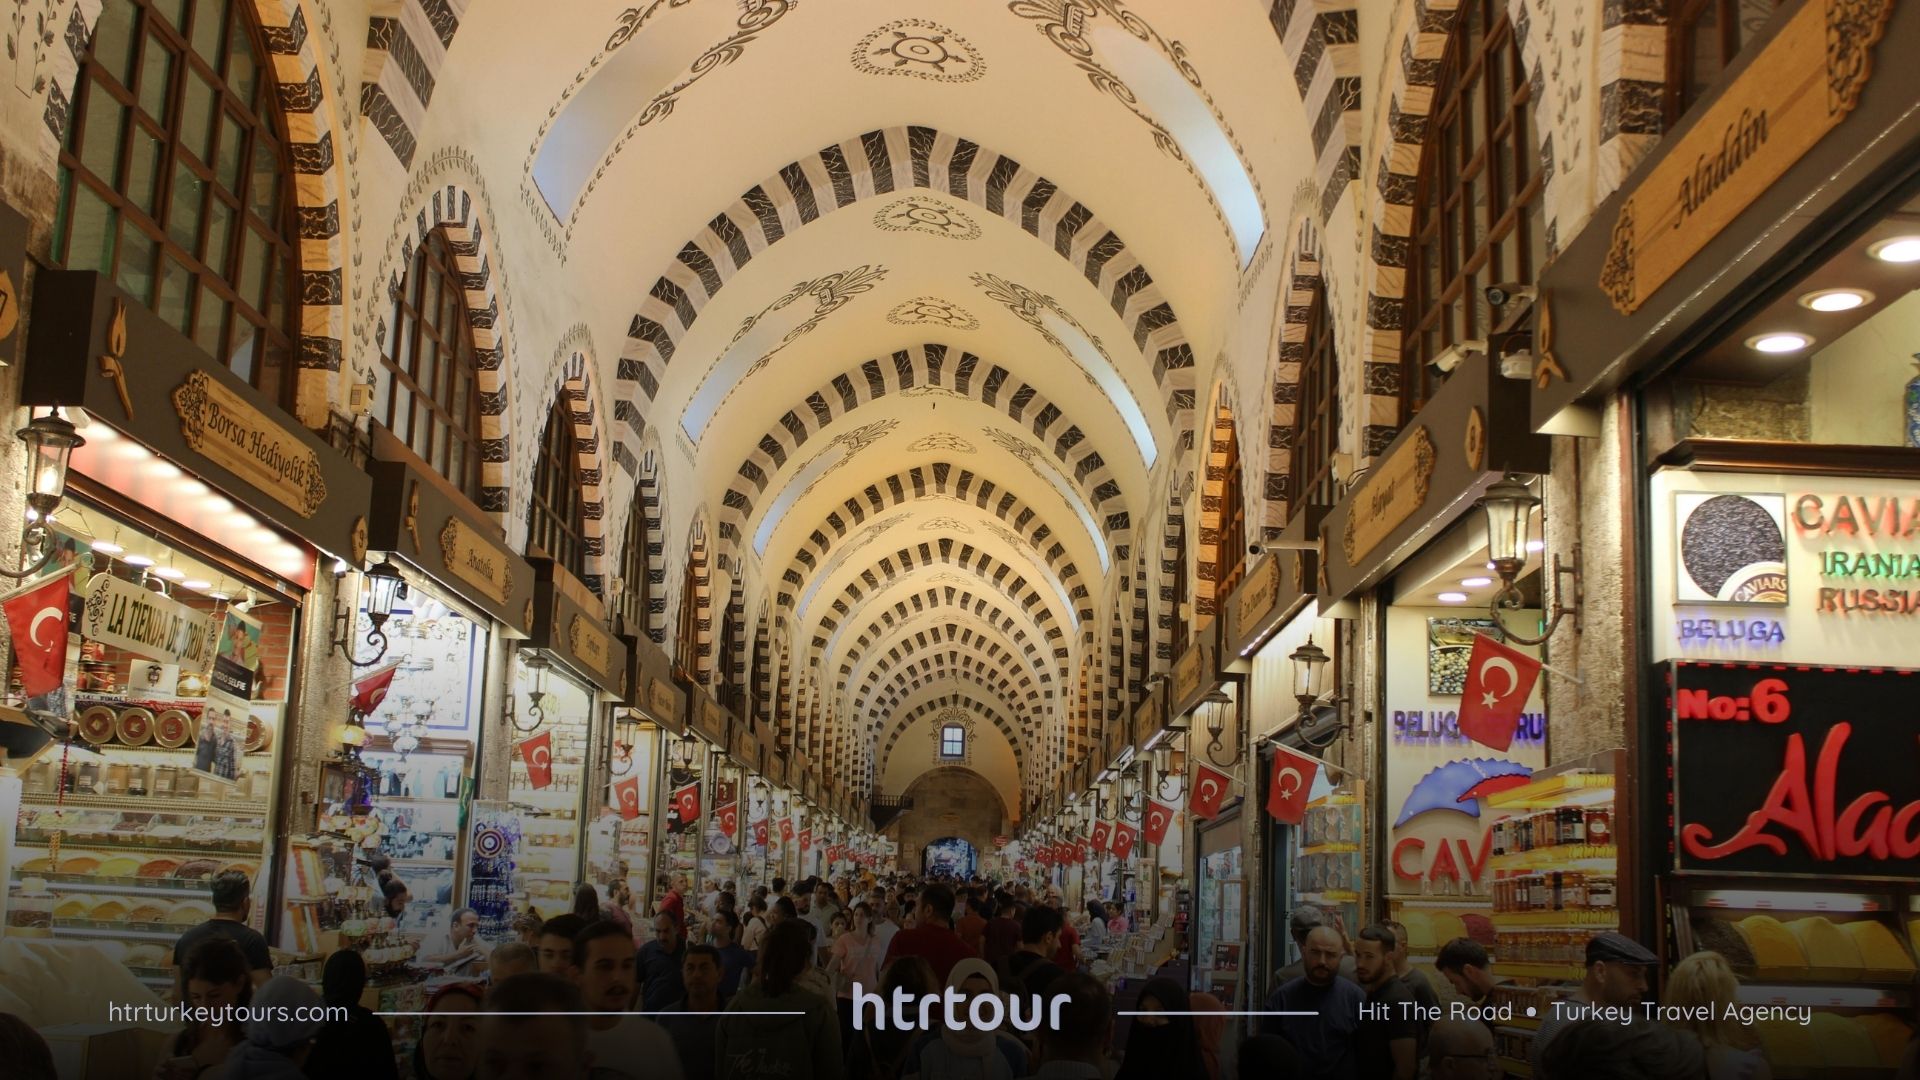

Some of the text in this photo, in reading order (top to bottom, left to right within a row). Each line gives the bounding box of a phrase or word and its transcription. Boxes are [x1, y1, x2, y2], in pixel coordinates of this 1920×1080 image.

[1673, 107, 1767, 230] Aladdin
[208, 403, 306, 487] Borsa Hediyelik
[1734, 576, 1787, 602] CAVIARS
[107, 593, 127, 635] LA
[1678, 618, 1785, 643] BELUGA
[1676, 678, 1791, 724] No:6
[1393, 710, 1462, 740] BELUG
